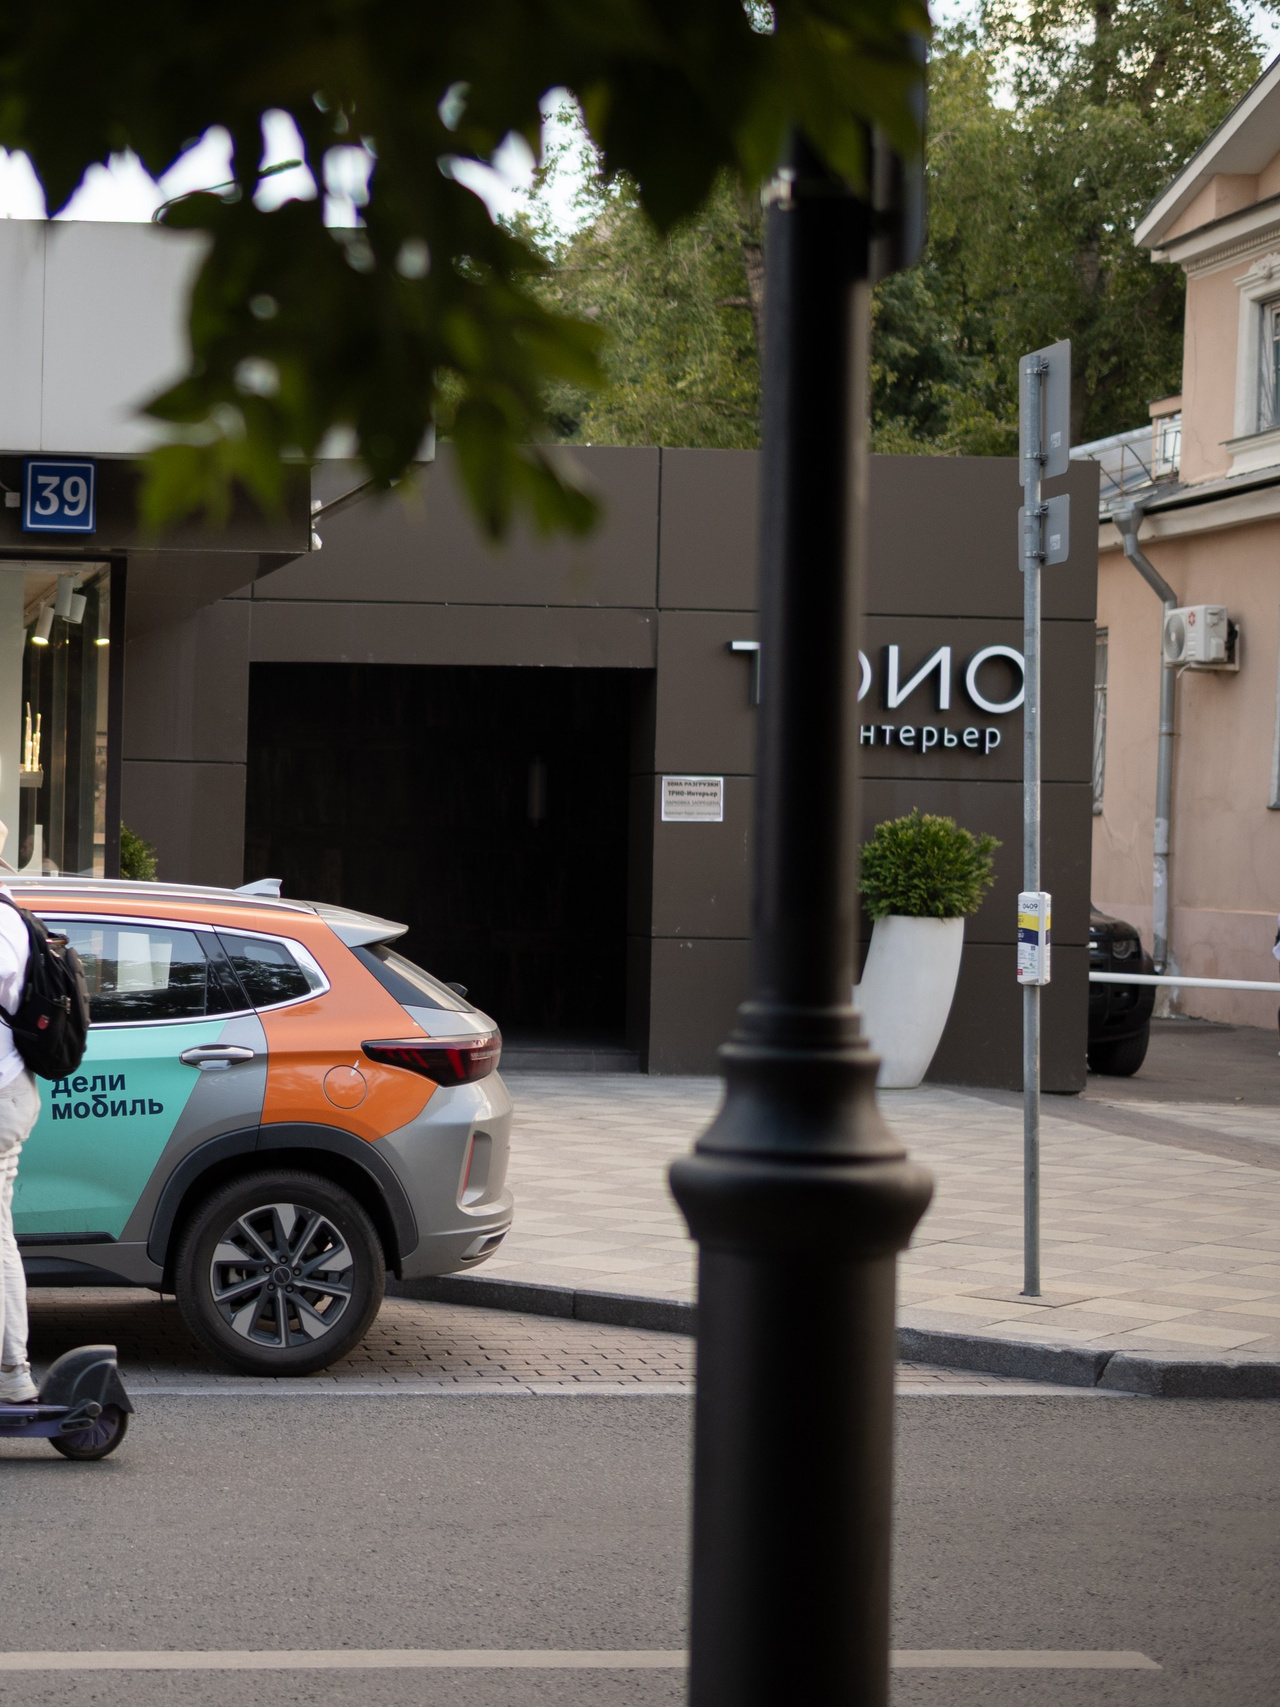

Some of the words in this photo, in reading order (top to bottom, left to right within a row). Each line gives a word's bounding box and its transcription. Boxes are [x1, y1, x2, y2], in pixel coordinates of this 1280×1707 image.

[34, 475, 88, 516] 39
[859, 724, 1001, 754] нтерьер
[51, 1074, 126, 1098] дели
[52, 1094, 164, 1120] мобиль
